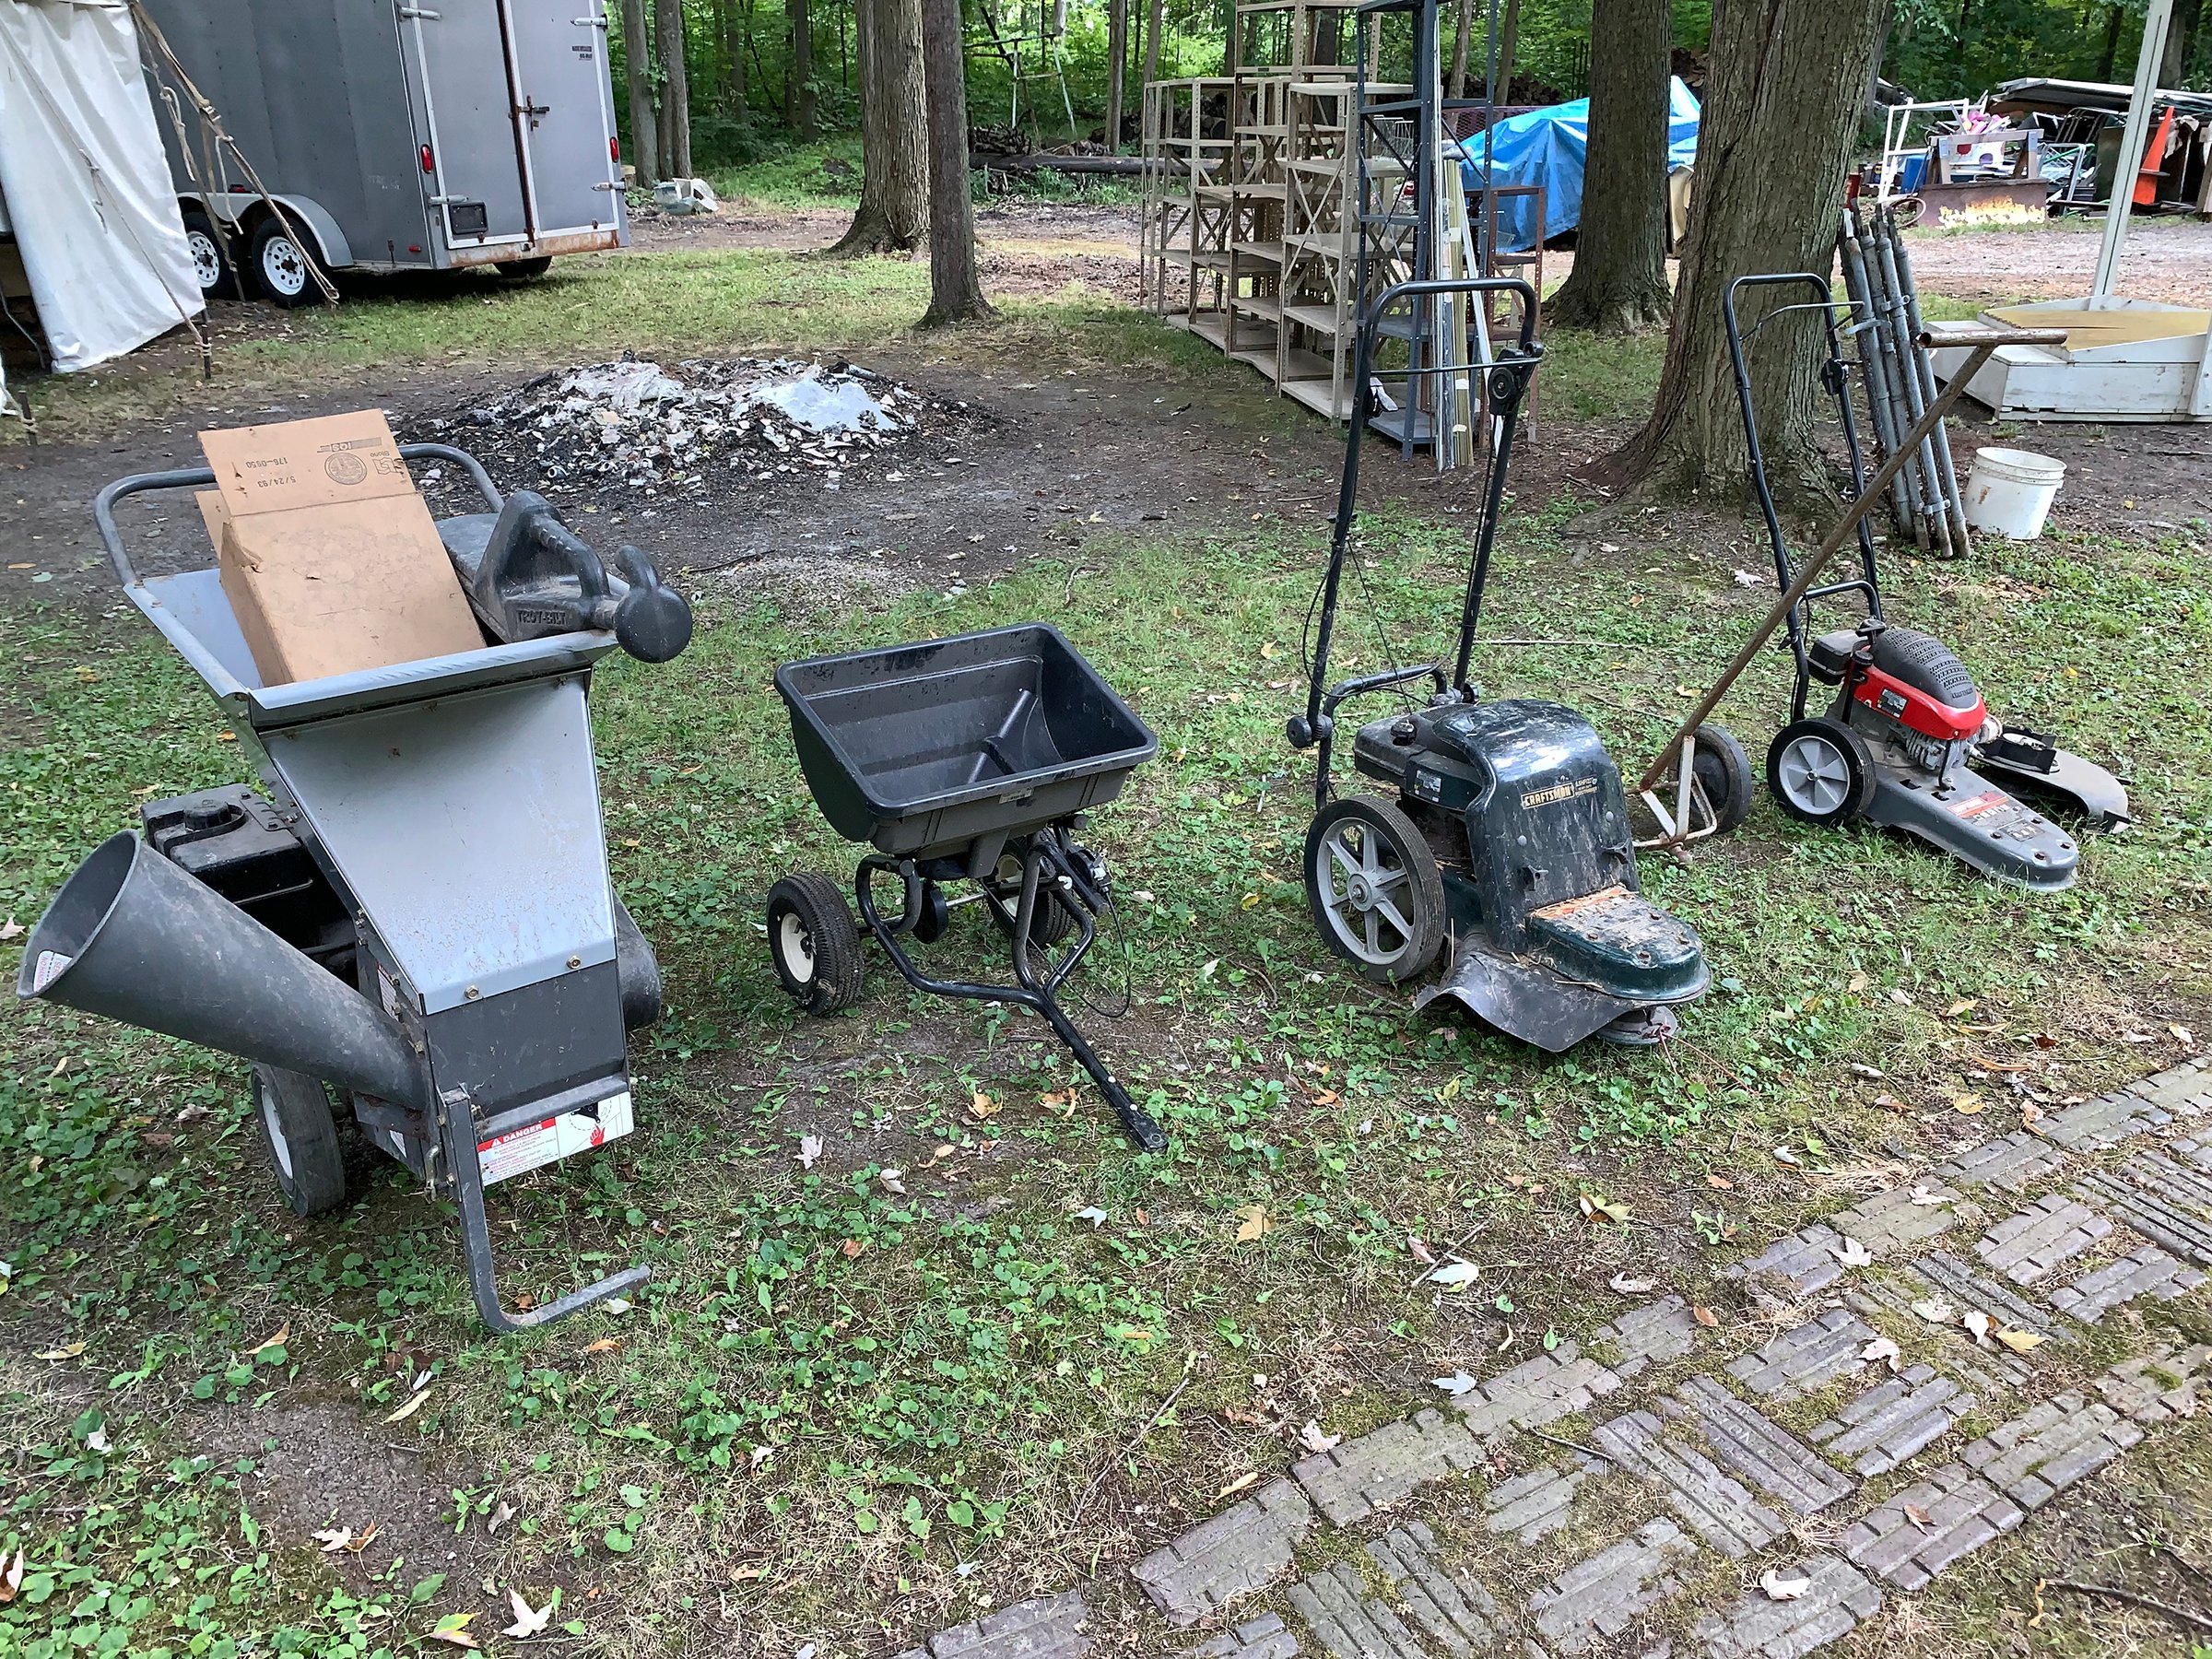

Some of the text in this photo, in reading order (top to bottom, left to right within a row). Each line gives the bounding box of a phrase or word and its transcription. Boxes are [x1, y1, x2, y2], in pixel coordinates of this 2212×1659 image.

[257, 476, 296, 488] 5/24/93
[1524, 785, 1572, 806] CRAFTSMAN
[502, 1124, 543, 1143] DANGER
